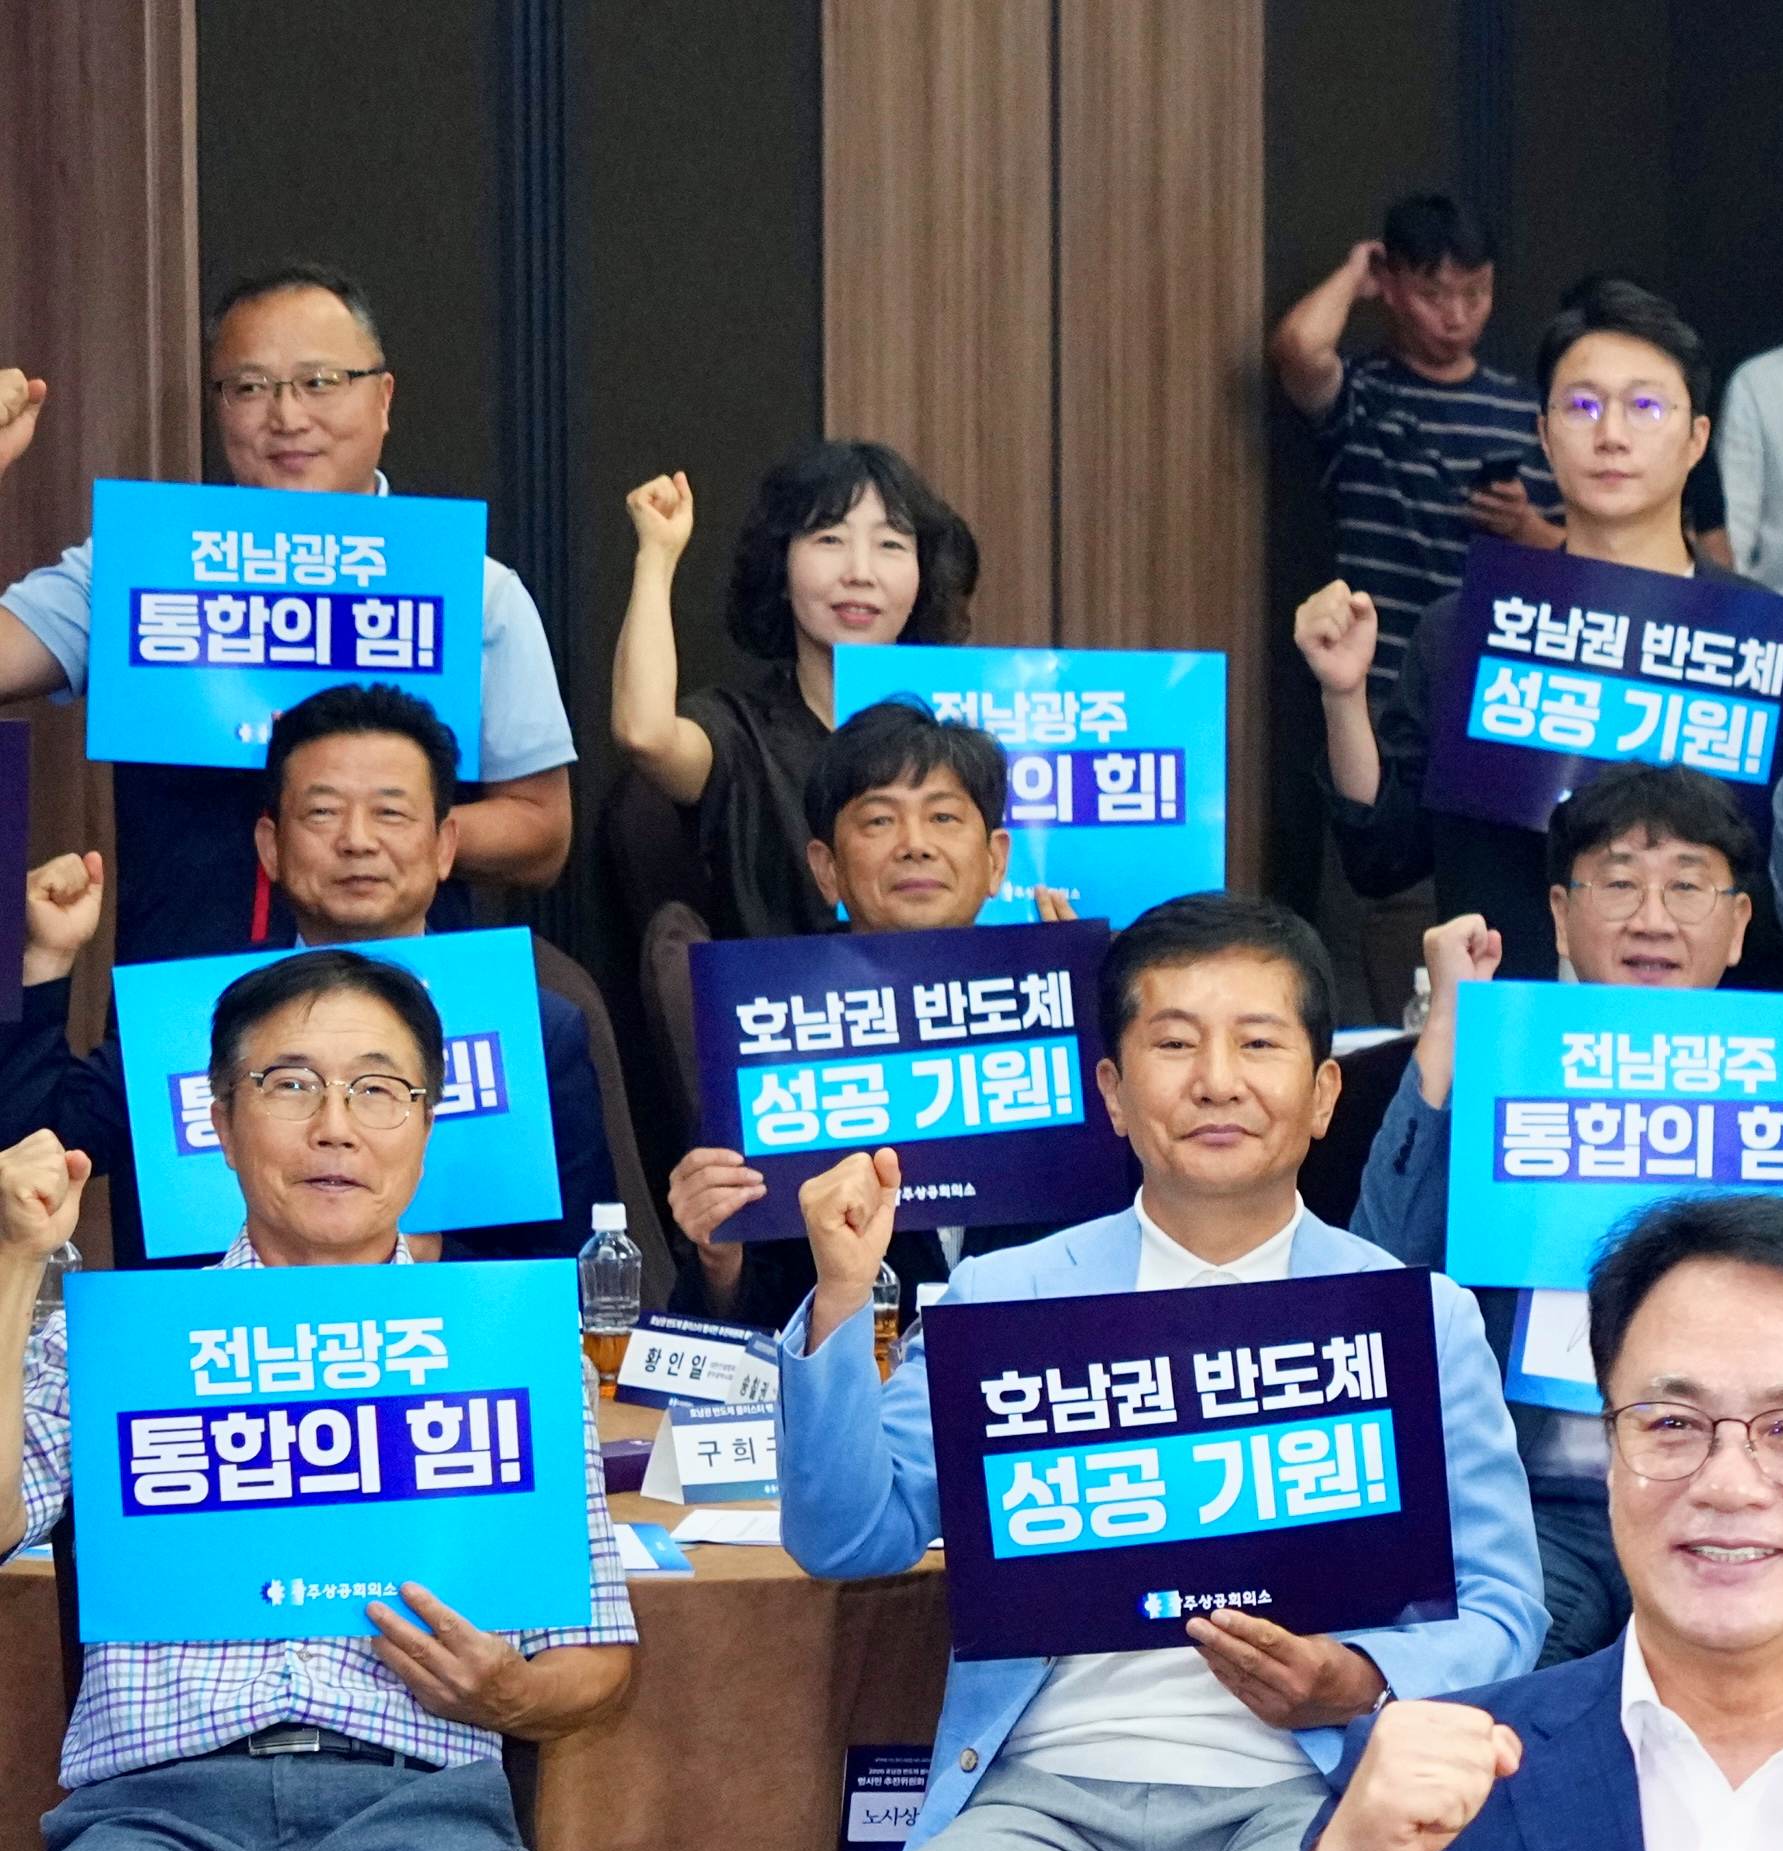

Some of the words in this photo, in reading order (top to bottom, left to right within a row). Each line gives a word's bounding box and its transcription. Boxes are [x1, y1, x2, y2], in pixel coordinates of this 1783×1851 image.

[191, 530, 388, 588] 전남광주
[137, 593, 332, 666] 통합의
[354, 597, 435, 669] 힘!
[1487, 597, 1629, 669] 호남권
[1478, 665, 1602, 758] 성공
[1615, 680, 1769, 774] 기원!
[1092, 752, 1177, 822] 힘!
[737, 986, 900, 1055] 호남권
[913, 971, 1075, 1042] 반도체
[752, 1061, 891, 1147] 성공
[912, 1045, 1072, 1131] 기원!
[1561, 1032, 1777, 1094] 전남광주
[1502, 1102, 1715, 1179] 통합의
[893, 1181, 976, 1208] 주상공회의소
[188, 1316, 449, 1396] 전남광주
[981, 1357, 1177, 1438] 호남권
[1193, 1332, 1389, 1418] 반도체
[129, 1407, 382, 1507] 통합의
[406, 1397, 522, 1491] 힘!
[1003, 1447, 1167, 1546] 성공
[1192, 1422, 1387, 1524] 기원!
[1167, 1588, 1273, 1617] 주상공회의소
